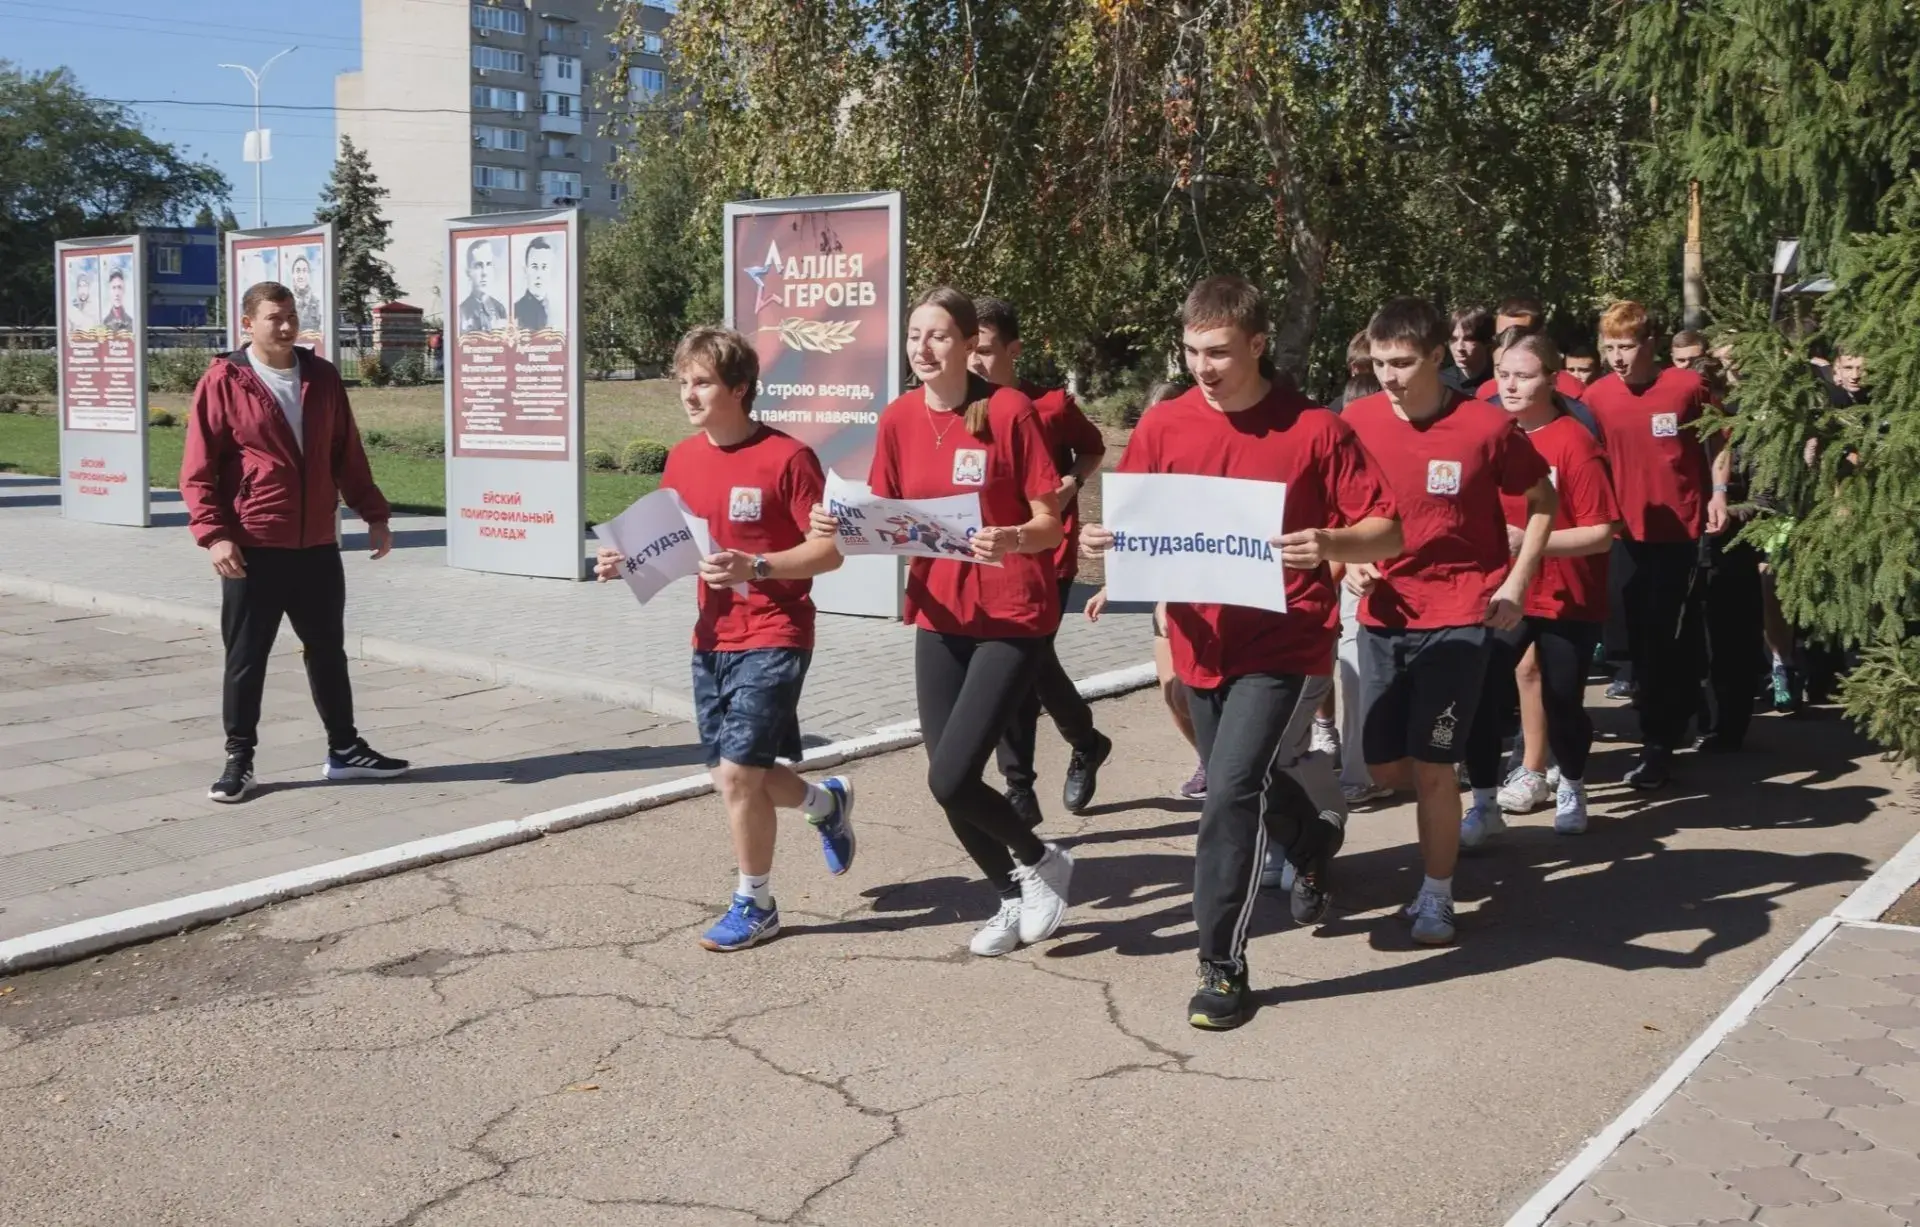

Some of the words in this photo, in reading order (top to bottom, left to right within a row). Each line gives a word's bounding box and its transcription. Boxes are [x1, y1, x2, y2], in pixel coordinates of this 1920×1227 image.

[783, 253, 863, 280] АЛЛЕЯ
[783, 281, 877, 308] ГЕРОЕВ
[767, 384, 815, 400] строю
[818, 385, 875, 400] всегда,
[761, 410, 812, 423] памяти
[815, 411, 879, 425] навечно
[483, 490, 522, 505] ЕЙСКИЙ
[479, 526, 526, 540] КОЛЛЕДЖ
